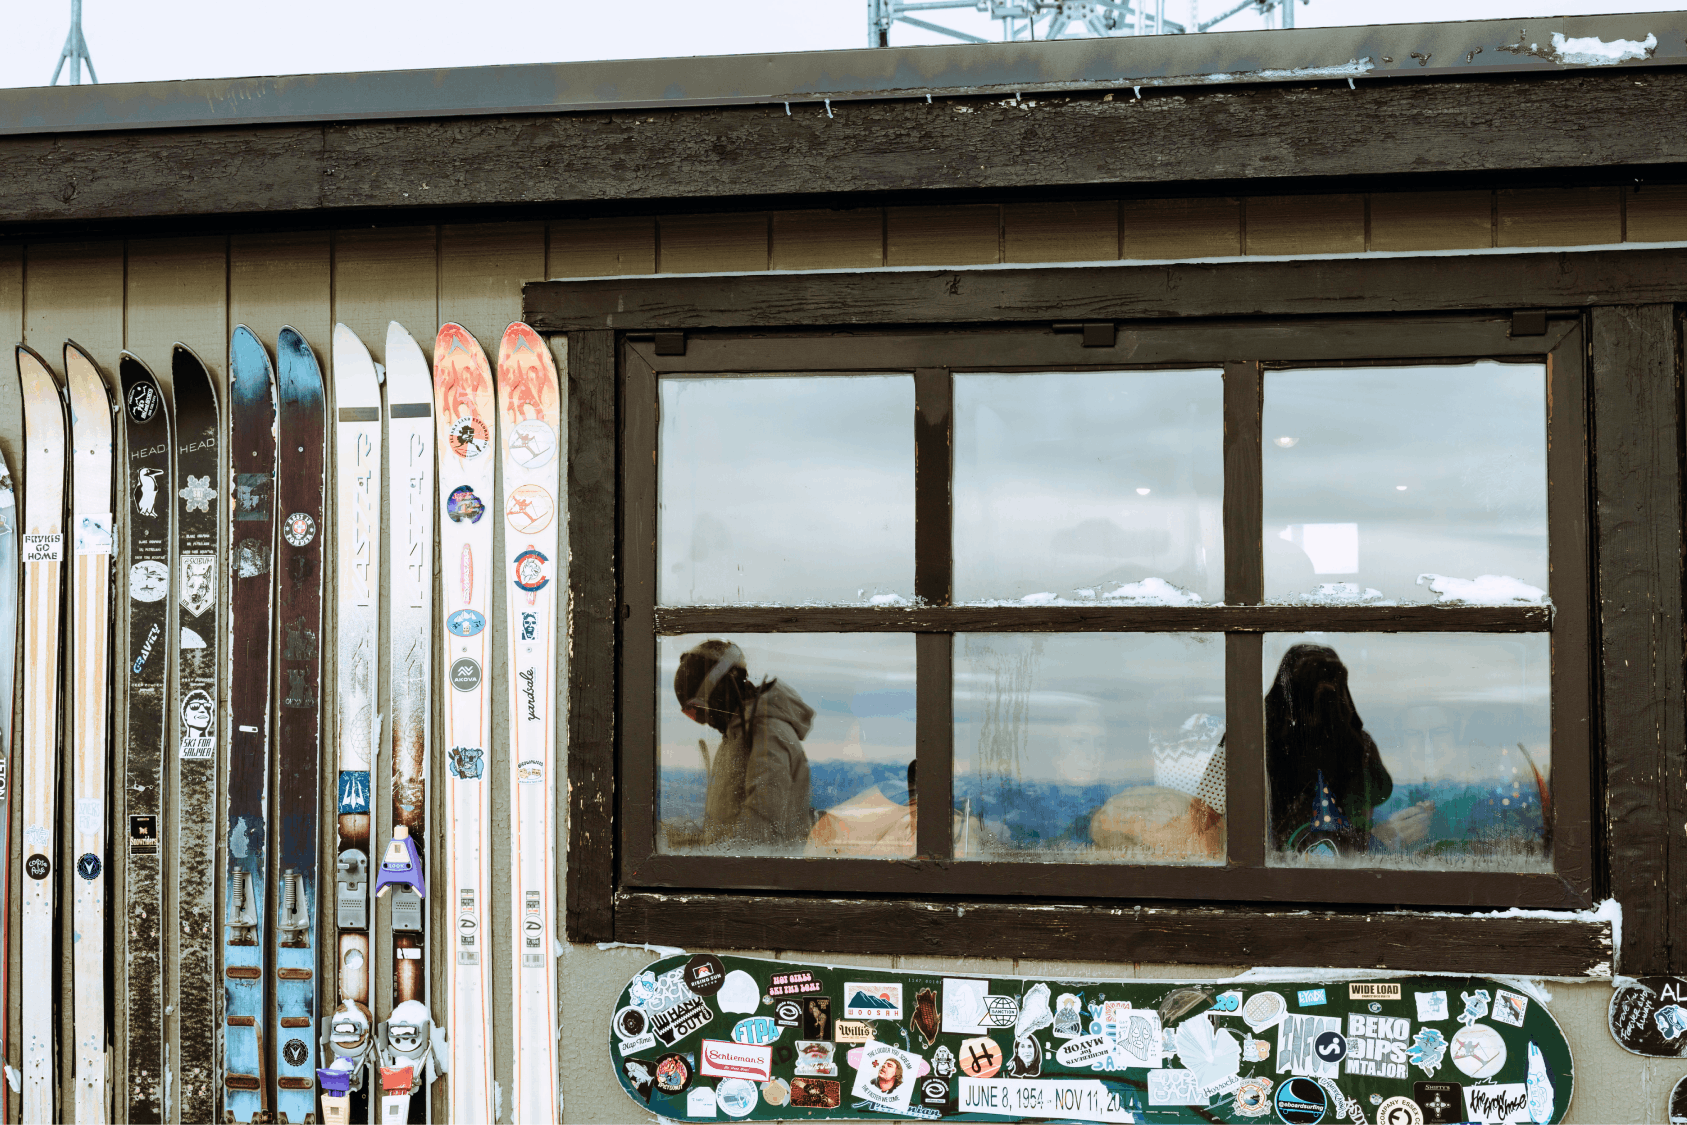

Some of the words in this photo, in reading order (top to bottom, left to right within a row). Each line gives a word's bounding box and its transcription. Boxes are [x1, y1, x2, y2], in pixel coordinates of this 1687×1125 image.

[131, 444, 166, 460] HEAD
[180, 438, 215, 455] HEAD
[28, 552, 58, 560] HOME
[36, 544, 50, 552] GO
[690, 978, 710, 986] RISING
[1352, 984, 1375, 994] WIDE
[1376, 984, 1398, 994] LOAD
[1349, 1014, 1410, 1041] BEKO
[622, 1041, 636, 1050] Nap
[636, 1036, 652, 1045] Time
[1064, 1037, 1104, 1054] MAYOR
[1348, 1038, 1408, 1064] DIPS
[1203, 1076, 1239, 1098] Horrocks
[966, 1085, 998, 1107] JUNE
[1002, 1086, 1012, 1112] 8,
[1016, 1088, 1043, 1110] 1954
[1056, 1088, 1083, 1110] NOV
[1087, 1090, 1103, 1114] 11,
[1380, 1100, 1399, 1125] COMPANY
[1402, 1100, 1420, 1116] ESSEX
